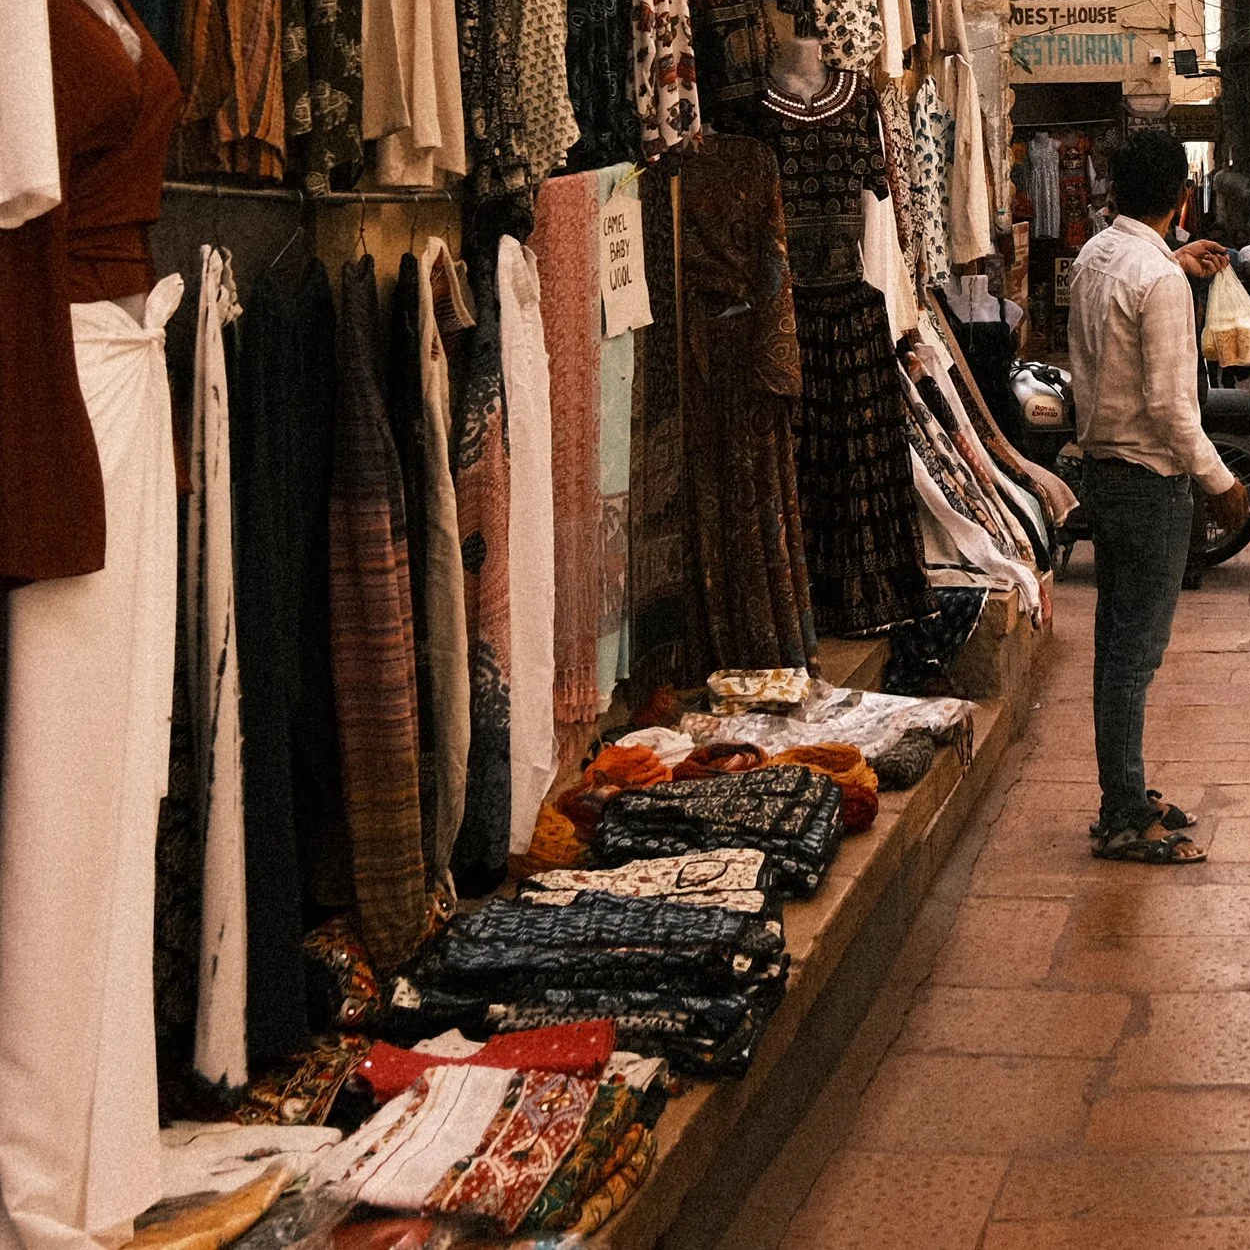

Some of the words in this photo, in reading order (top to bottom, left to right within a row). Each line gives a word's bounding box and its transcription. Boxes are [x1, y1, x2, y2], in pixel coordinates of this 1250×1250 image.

[1014, 33, 1137, 66] ESTAURANT
[603, 213, 628, 236] CAMEL
[610, 239, 630, 262] BABY
[609, 264, 632, 291] WOOL
